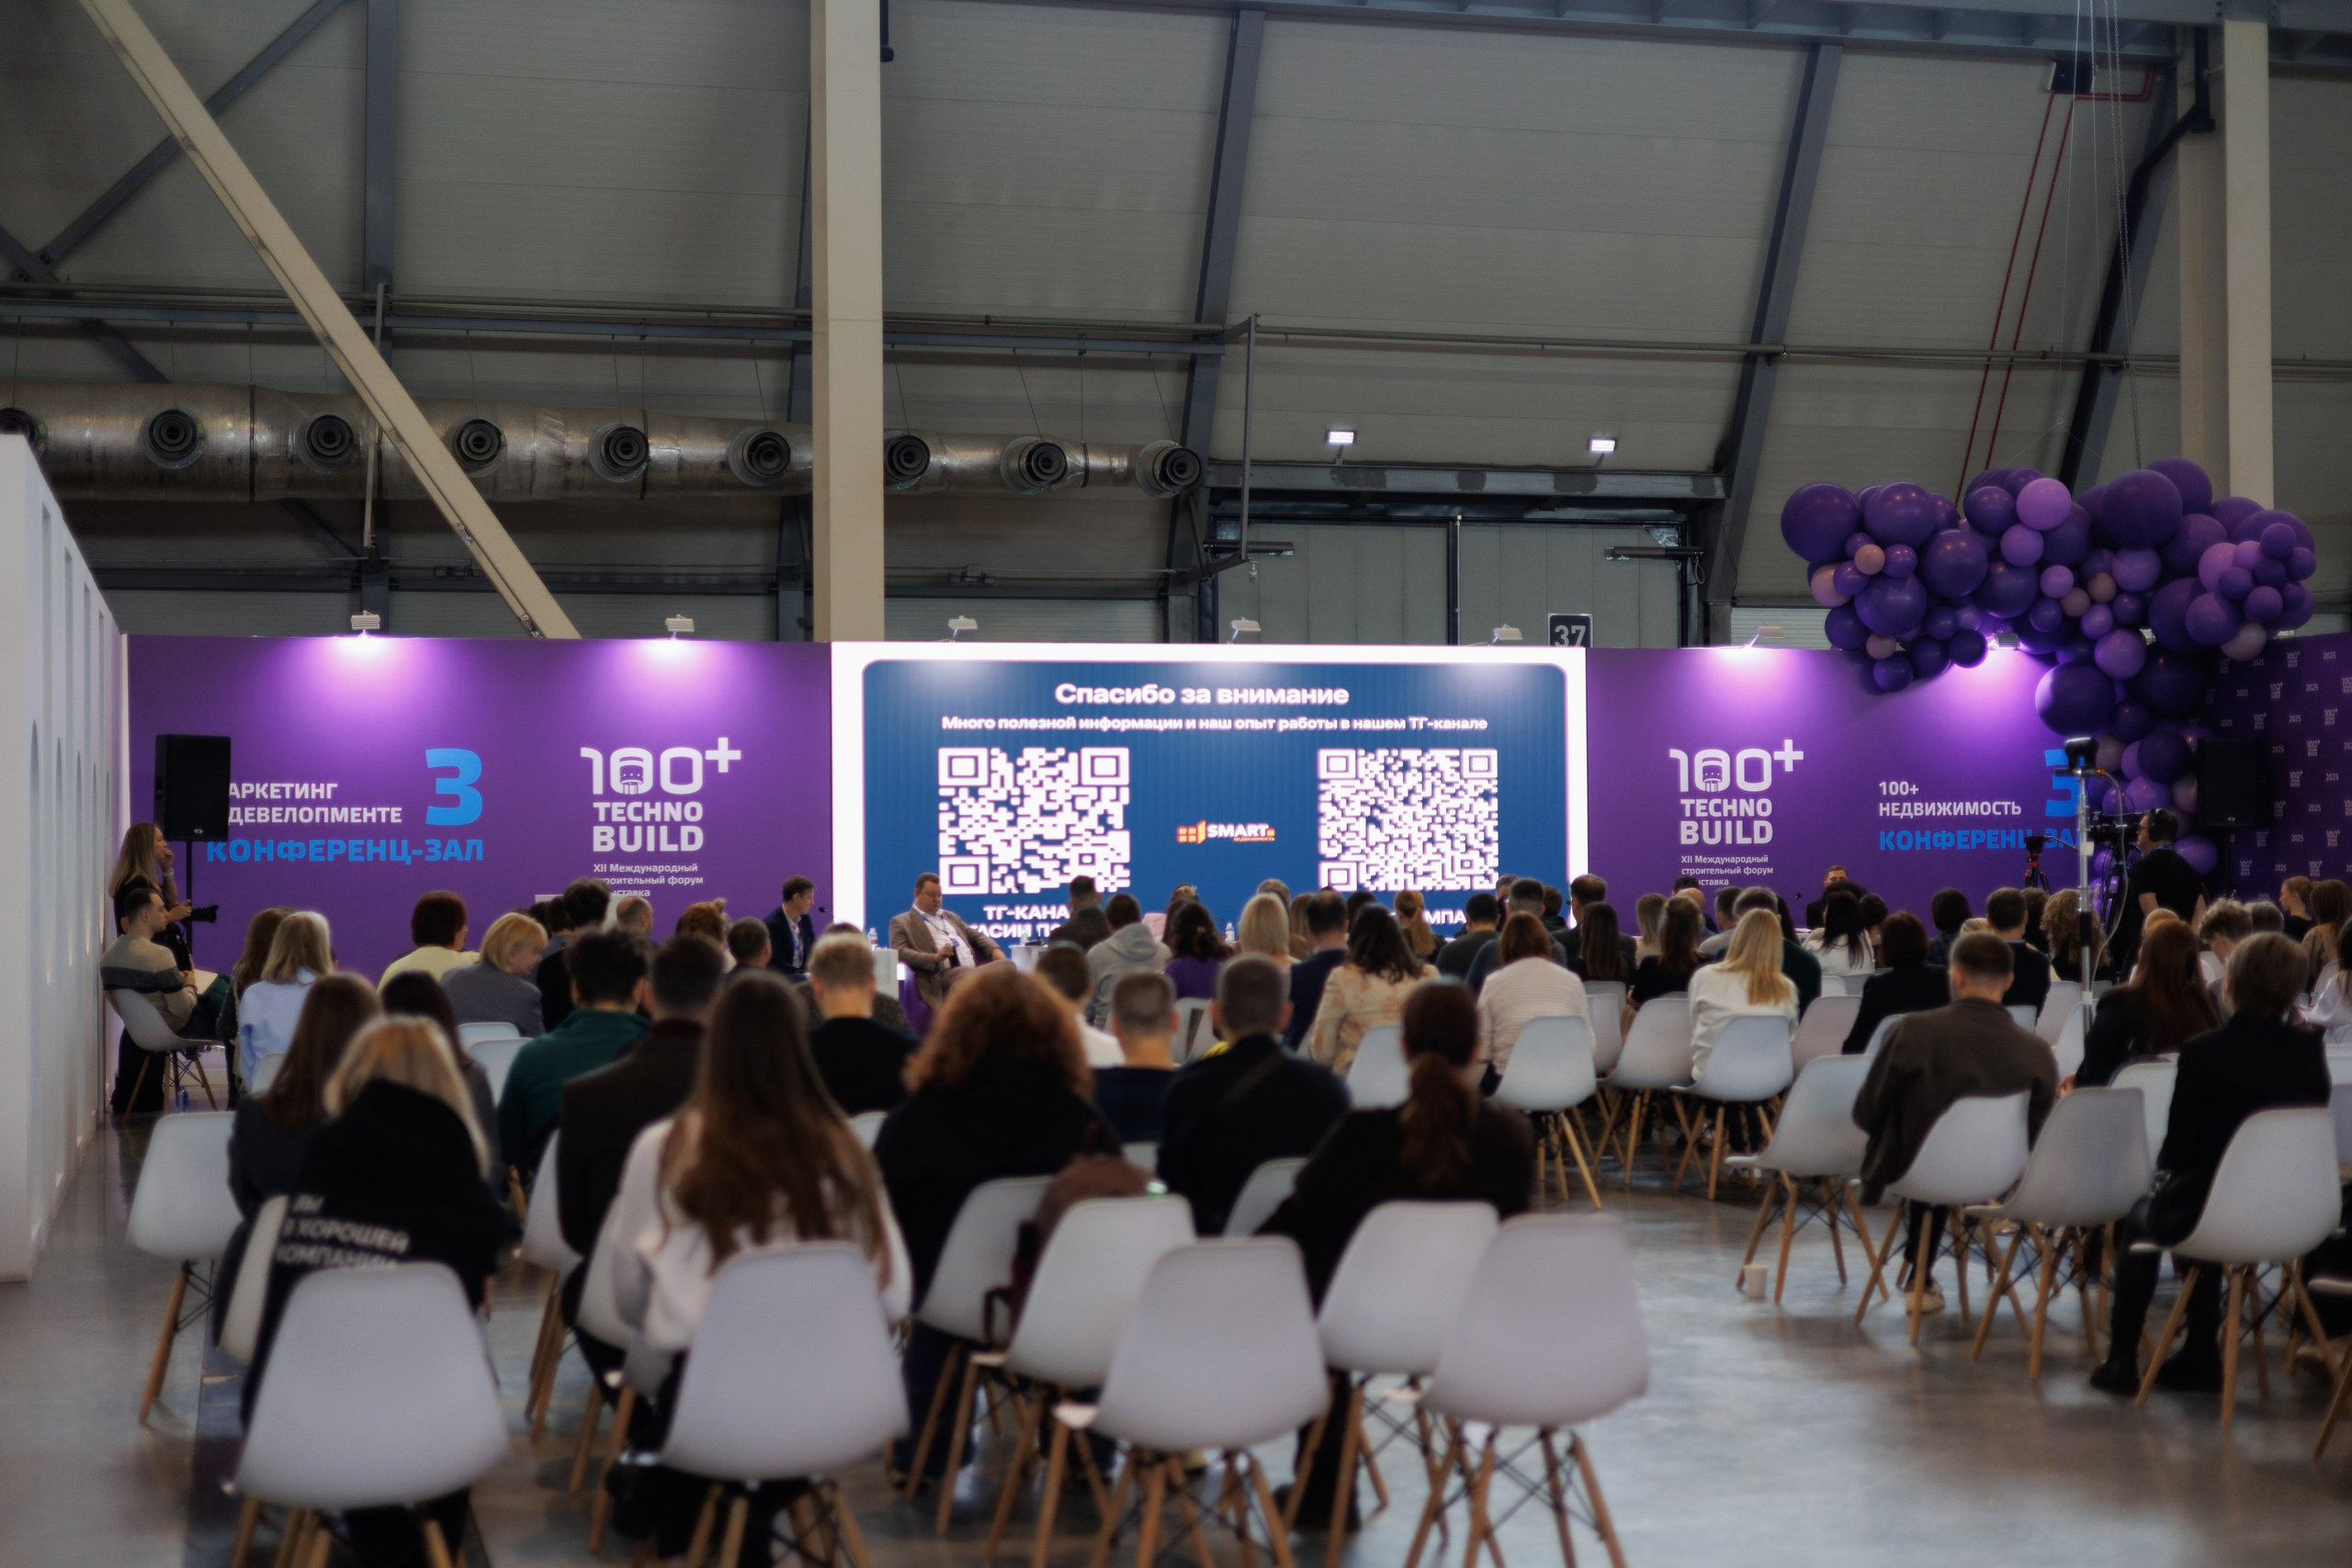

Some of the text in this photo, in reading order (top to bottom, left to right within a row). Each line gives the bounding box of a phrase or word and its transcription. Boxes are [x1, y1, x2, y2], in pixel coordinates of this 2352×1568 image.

[1555, 625, 1586, 648] 37
[2324, 651, 2336, 660] 2025
[1055, 683, 1350, 705] Спасибо за внимание
[2236, 689, 2249, 697] 2025
[2306, 683, 2319, 692] 2025
[942, 716, 1488, 732] Много полезной информации и наш опыт работы в нашем ТГ-канале
[2289, 715, 2301, 723] 2025
[229, 783, 338, 799] АРКЕТИНГ
[424, 748, 483, 826] 3
[1879, 781, 1919, 795] 100+
[593, 802, 703, 822] TECHNO
[1680, 798, 1773, 817] TECHNO
[1879, 801, 2022, 818] НЕДВИЖИМОСТЬ
[228, 807, 402, 826] ДЕВЕЛОПМЕНТЕ
[593, 825, 704, 852] BUILD
[1207, 824, 1270, 838] SMART
[1680, 820, 1774, 845] BUILD
[2290, 834, 2304, 842] 2025
[207, 839, 483, 865] КОНФЕРЕНЦ-ЗАЛ
[1681, 855, 1769, 864] XII Международный
[594, 863, 698, 874] XII Международный
[1681, 866, 1774, 875] строительный форум
[668, 876, 704, 886] форум
[983, 905, 1070, 919] ТГ-КАНА
[1423, 909, 1467, 924] МПА
